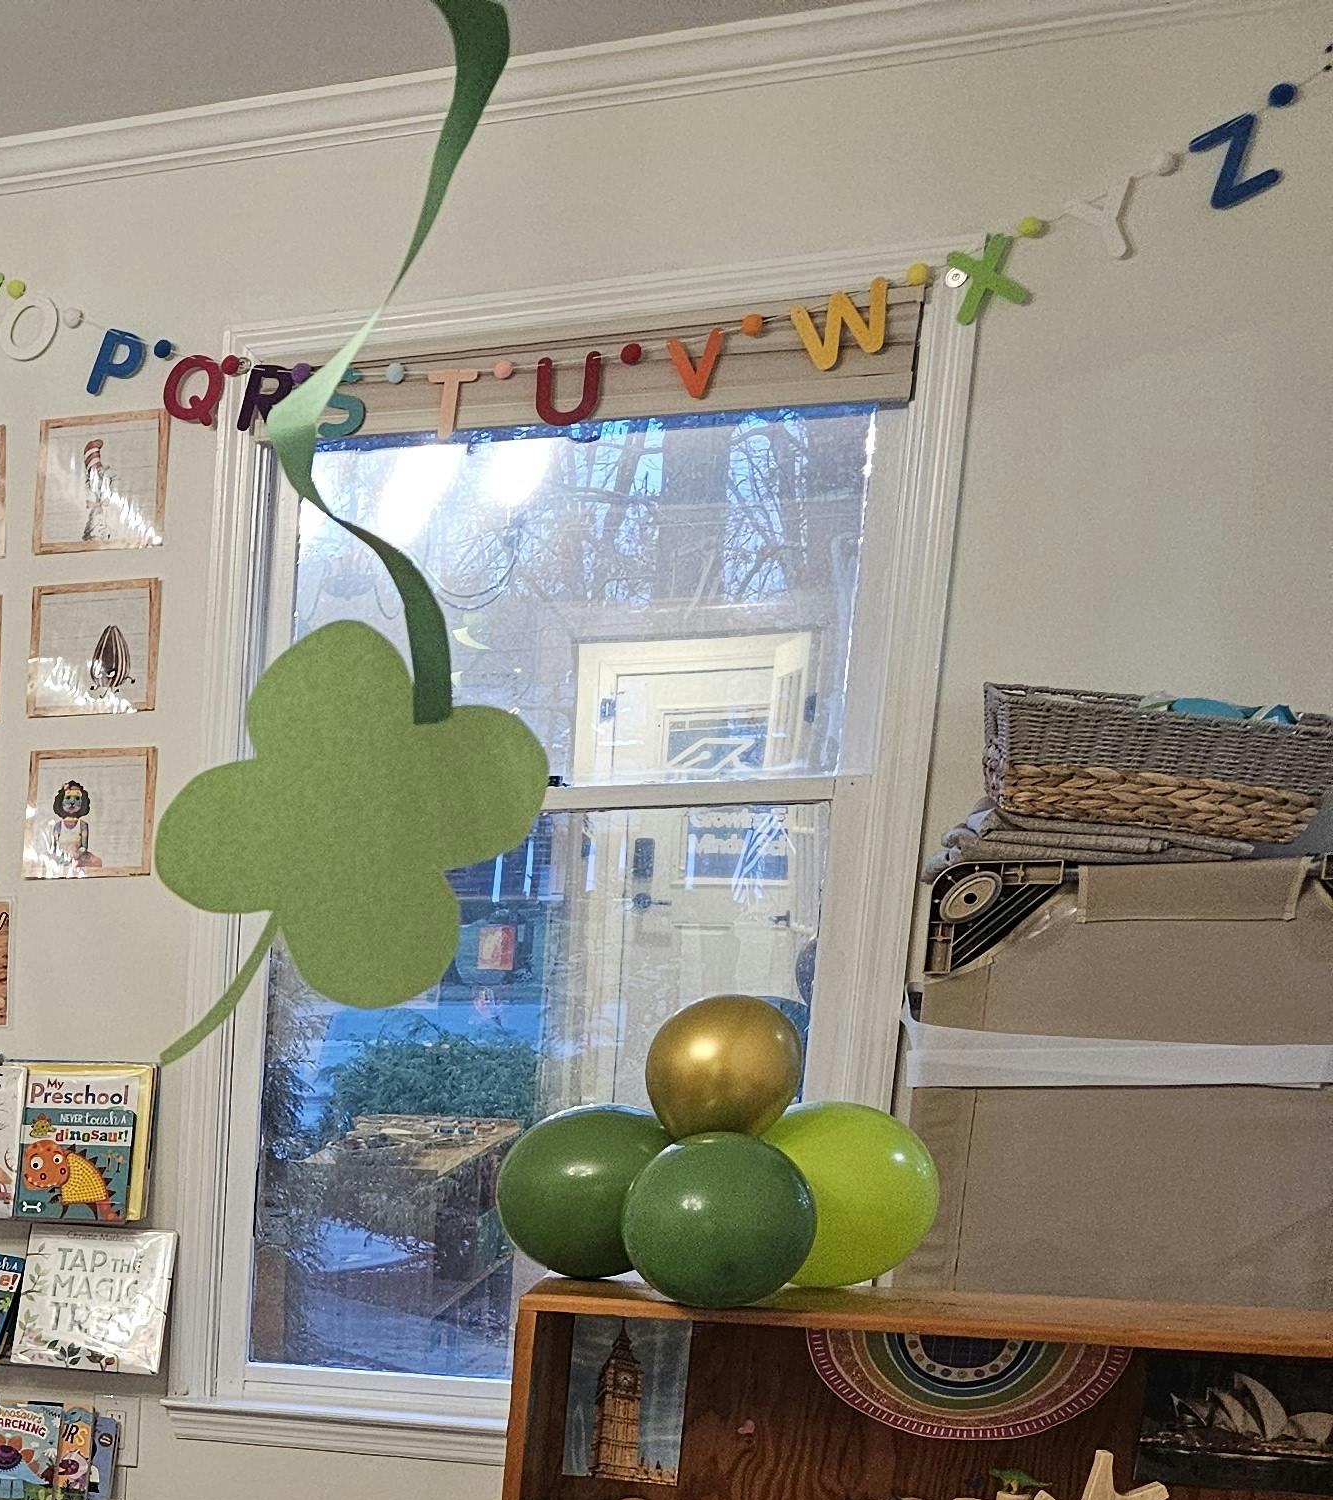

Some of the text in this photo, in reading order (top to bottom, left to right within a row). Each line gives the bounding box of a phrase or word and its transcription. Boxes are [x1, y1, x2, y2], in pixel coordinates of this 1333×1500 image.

[85, 327, 146, 396] P
[163, 354, 225, 427] Q
[236, 364, 295, 432] R
[428, 368, 480, 440] T
[534, 351, 603, 429] U
[666, 329, 724, 401] V
[790, 276, 890, 372] W
[946, 232, 1033, 326] X
[1063, 174, 1138, 261] Y
[1188, 112, 1283, 212] Z
[30, 1083, 129, 1104] Preschool
[47, 1078, 64, 1090] My
[60, 1113, 82, 1123] NEVER
[85, 1110, 119, 1125] touch
[55, 1129, 128, 1142] dinosaur!
[58, 1248, 142, 1274] TAP THE
[52, 1274, 140, 1301] MAGIC
